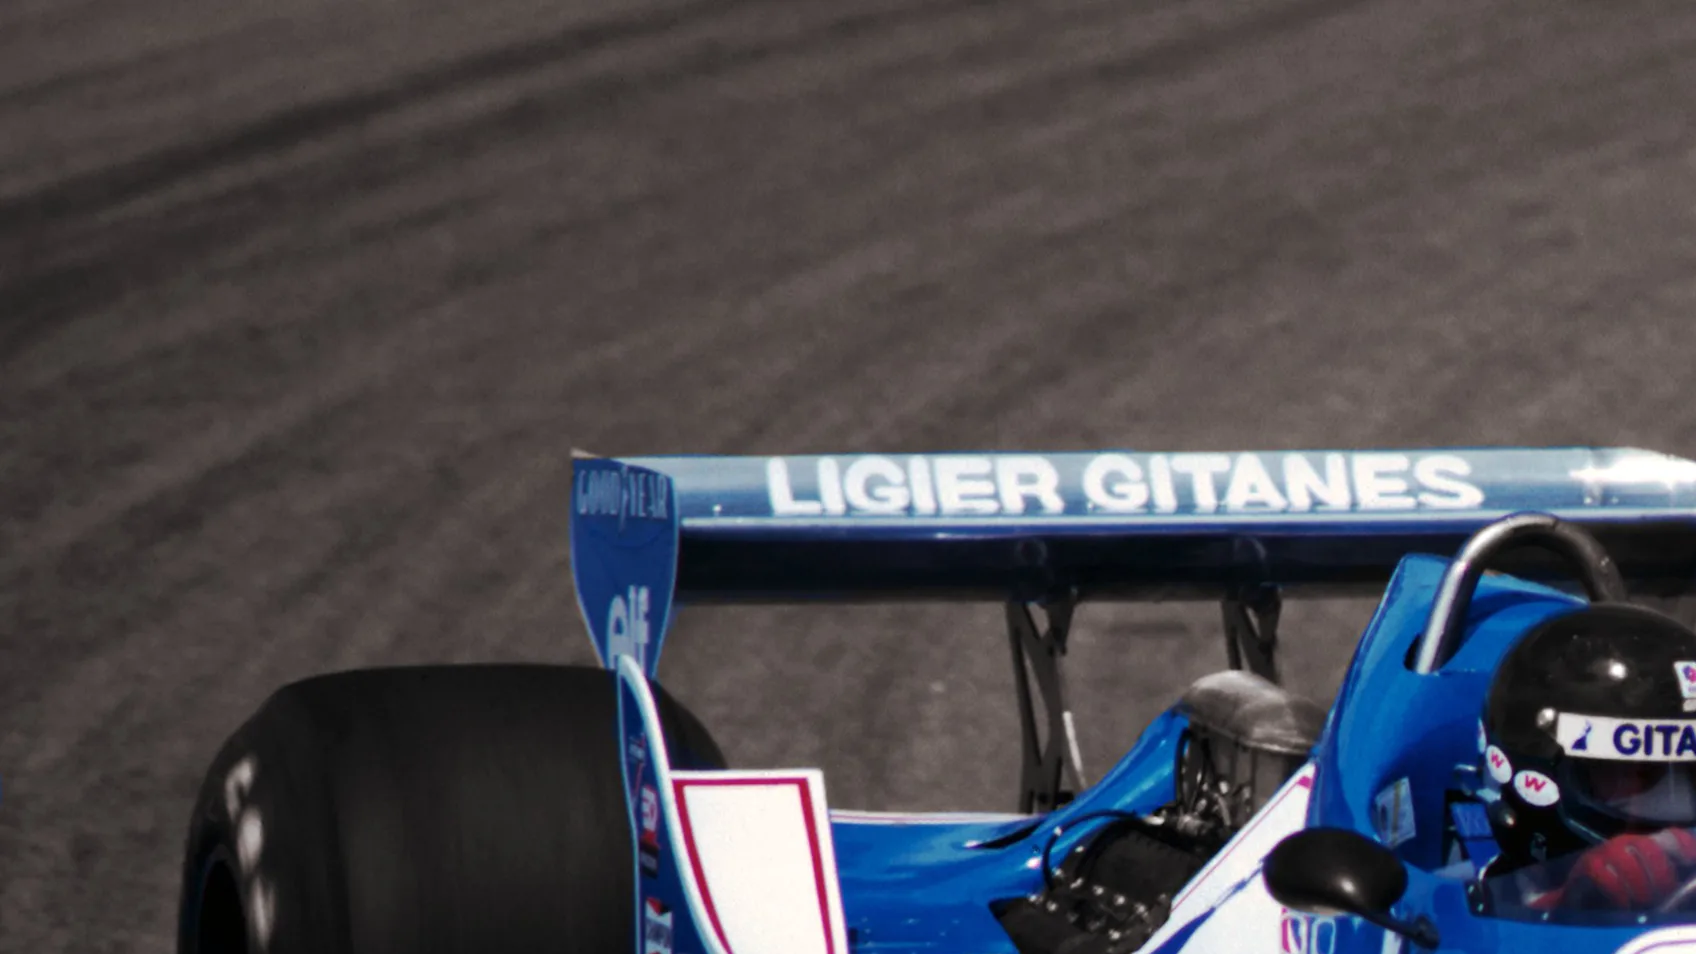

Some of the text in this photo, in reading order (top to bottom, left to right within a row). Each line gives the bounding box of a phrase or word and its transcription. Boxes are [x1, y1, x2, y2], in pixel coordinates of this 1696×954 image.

[576, 465, 668, 521] GOODYEAR
[767, 452, 1485, 516] LIGIER GITANES
